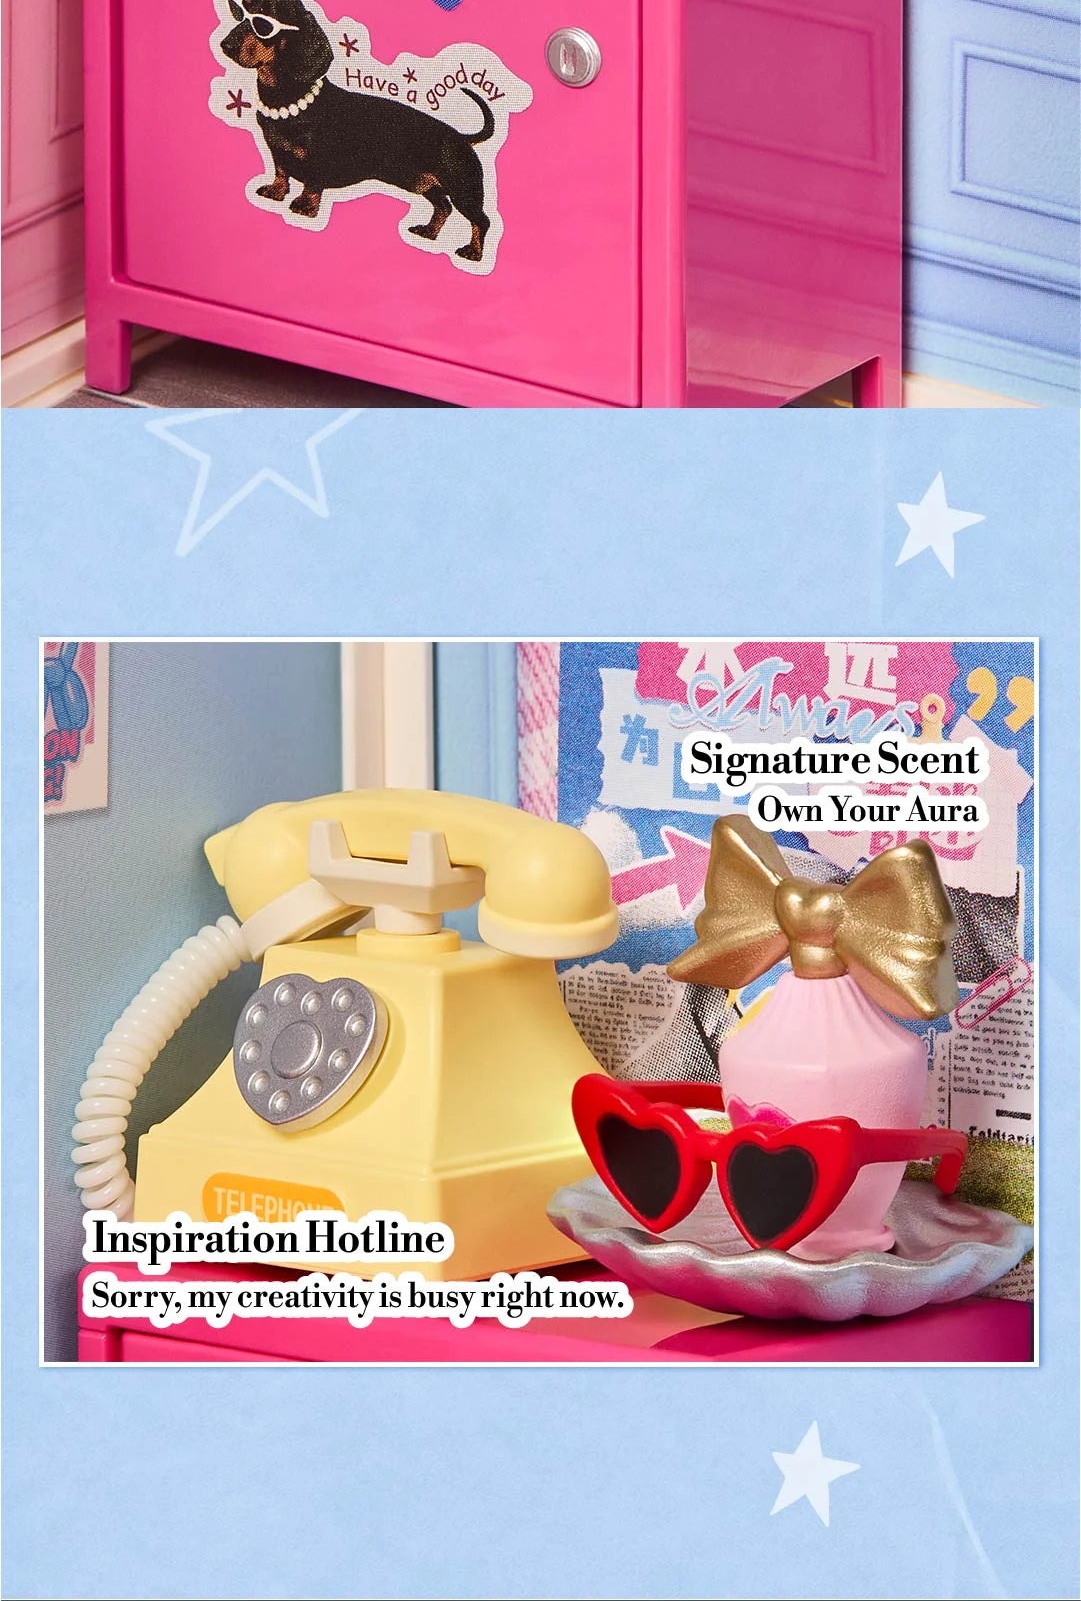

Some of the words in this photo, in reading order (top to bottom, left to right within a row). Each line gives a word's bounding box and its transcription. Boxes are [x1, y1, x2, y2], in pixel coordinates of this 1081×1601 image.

[345, 67, 400, 97] Have
[405, 88, 418, 104] a
[425, 62, 469, 111] good
[470, 69, 506, 102] day
